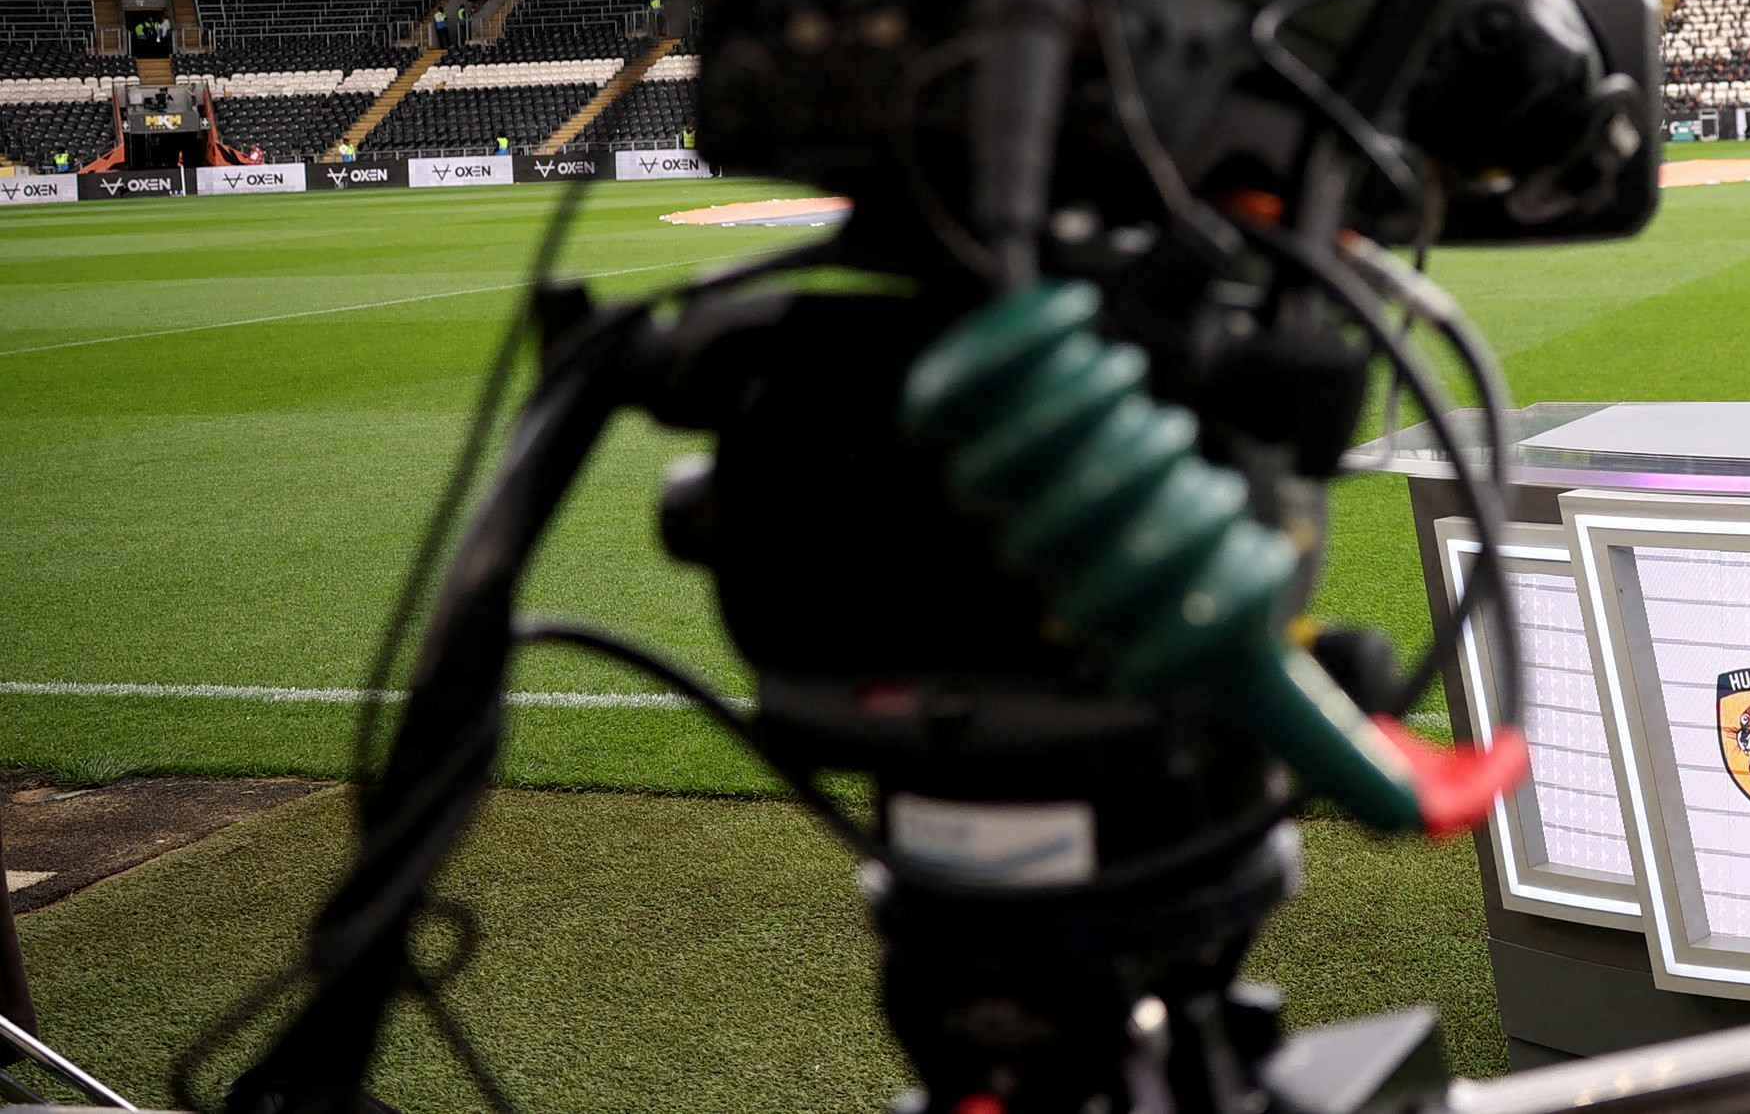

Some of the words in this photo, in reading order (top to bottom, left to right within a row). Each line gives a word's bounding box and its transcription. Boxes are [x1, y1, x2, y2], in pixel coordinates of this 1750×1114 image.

[145, 114, 182, 130] MKM
[455, 165, 491, 178] OXEN
[558, 161, 595, 175] OXEN
[662, 159, 698, 172] OXEN
[247, 173, 283, 186] OXEN
[350, 168, 388, 182] OXEN
[24, 184, 58, 197] OXEN
[127, 177, 171, 192] OXEN
